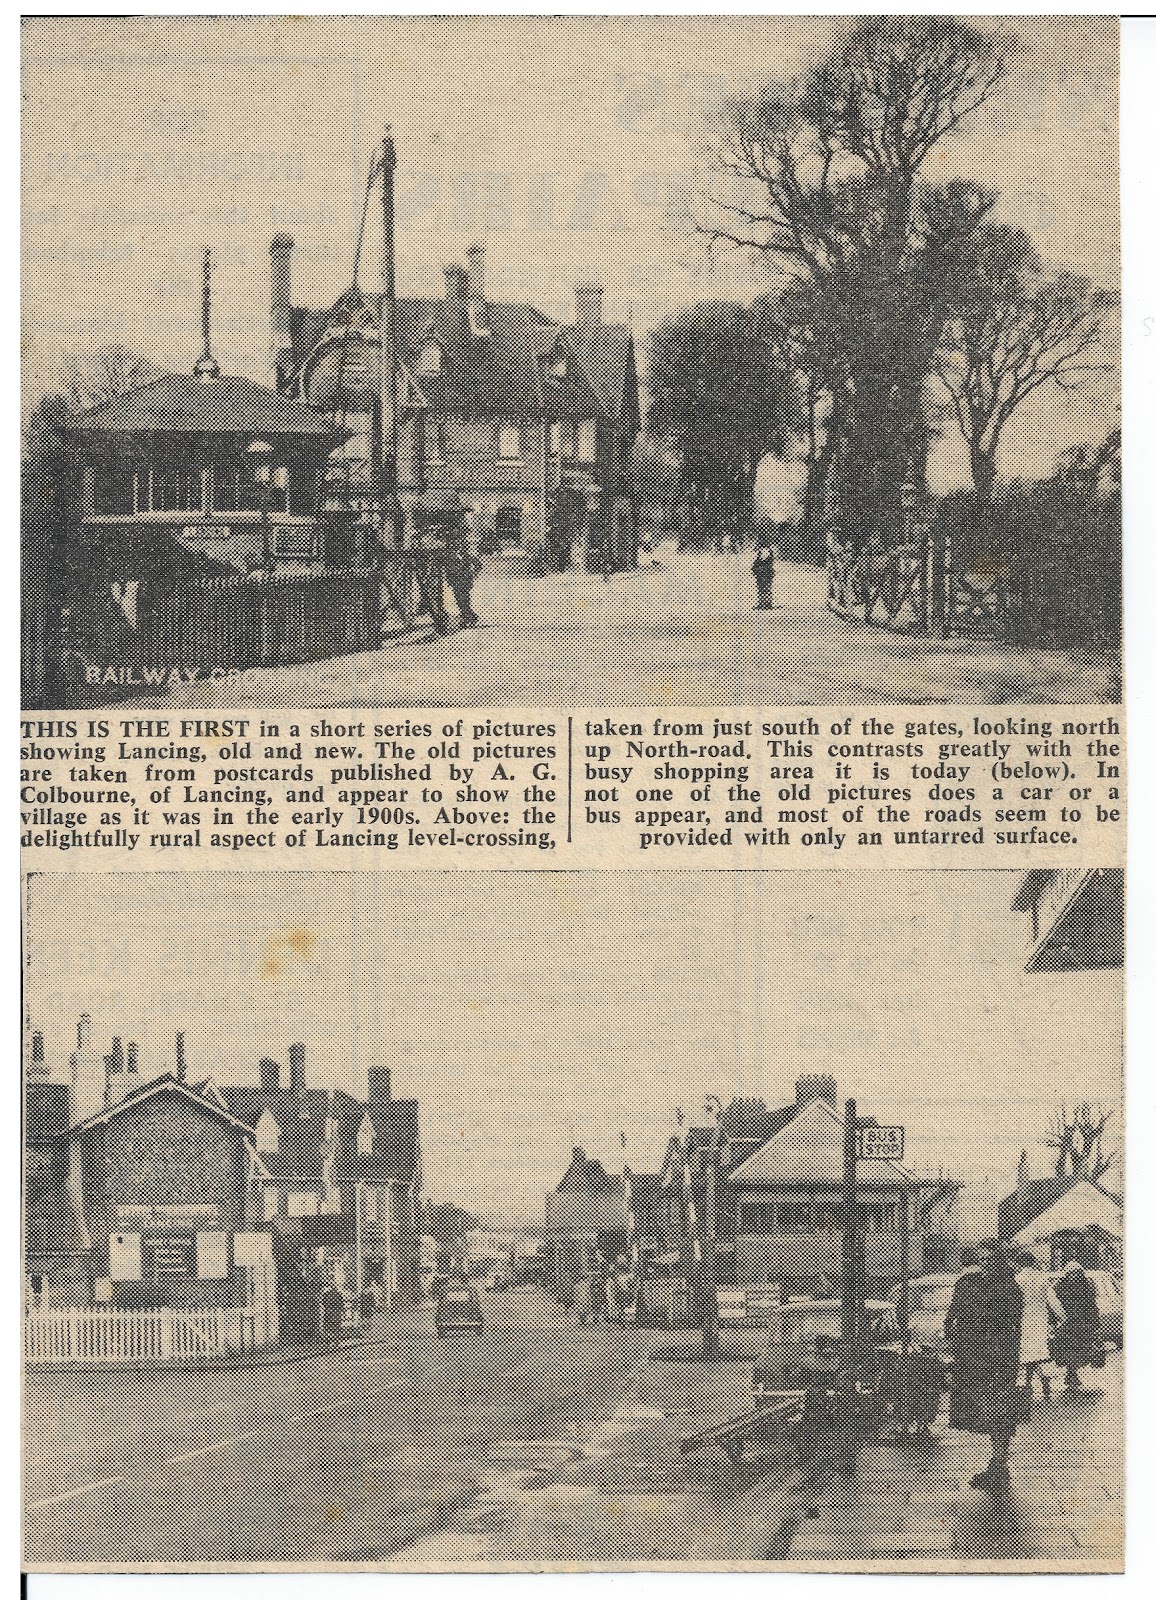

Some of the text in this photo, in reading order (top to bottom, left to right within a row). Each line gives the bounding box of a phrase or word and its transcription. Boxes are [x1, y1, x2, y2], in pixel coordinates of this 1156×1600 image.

[21, 719, 556, 739] THIS IS THE FIRST in a short series of pictures
[584, 717, 1119, 738] taken from just south of the gates, looking north
[21, 741, 555, 762] showing Lancing, old and new. The old pictures
[584, 739, 1119, 761] up North-road. This contrasts greatly with the
[21, 763, 555, 784] are taken from postcards published by A. G.
[584, 761, 1119, 783] busy shopping area it is today (below). In
[21, 785, 555, 806] Colbourne, of Lancing, and appear to show the
[584, 784, 1119, 803] not one of the old pictures does a car or a
[21, 807, 555, 828] village as it was in the early 1900s. Above: the
[584, 805, 1119, 826] bus appear, and most of the roads seem to be
[21, 828, 555, 850] delightfully rural aspect of Lancing level-crossing,
[639, 826, 1077, 849] provided with only an untarred surface.
[867, 1129, 898, 1142] BUS
[865, 1143, 901, 1156] STOP
